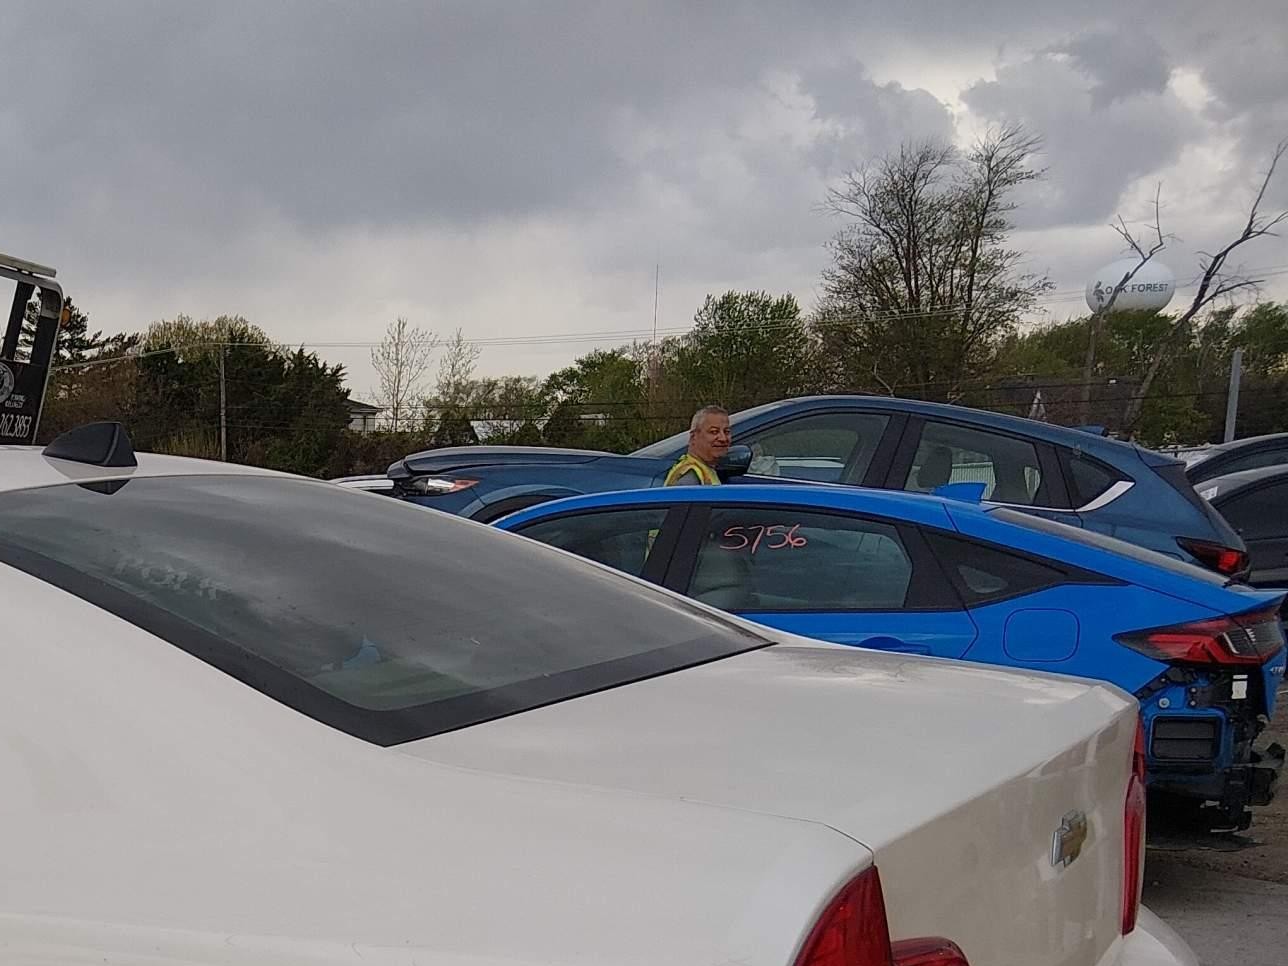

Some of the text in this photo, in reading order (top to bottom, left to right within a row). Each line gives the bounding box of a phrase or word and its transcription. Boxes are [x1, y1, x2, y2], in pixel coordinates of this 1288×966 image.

[1105, 283, 1169, 295] OK FOREST
[719, 523, 808, 555] 5756
